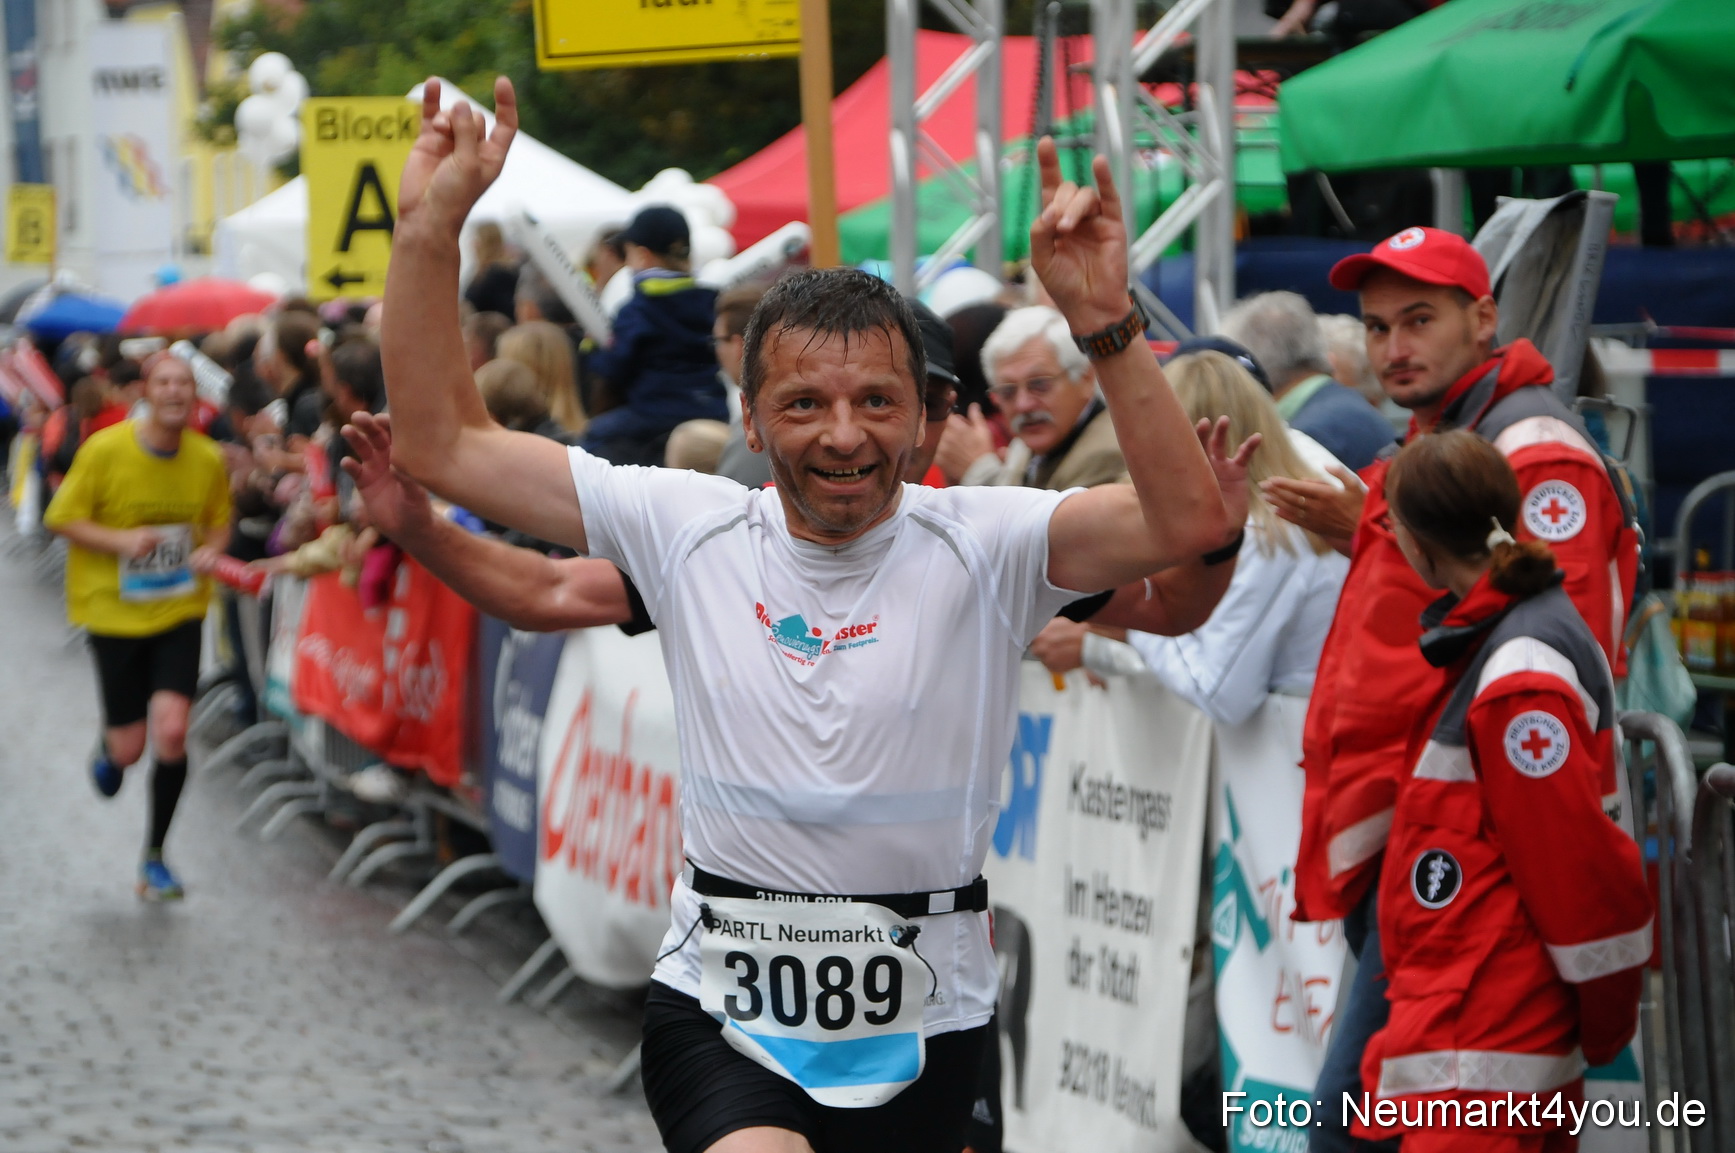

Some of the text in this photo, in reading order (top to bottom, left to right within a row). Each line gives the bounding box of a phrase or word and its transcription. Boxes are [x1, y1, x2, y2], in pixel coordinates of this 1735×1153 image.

[315, 106, 420, 140] Block
[331, 160, 395, 253] A
[710, 918, 885, 943] PARTL Neumarkt
[724, 951, 903, 1031] 3089
